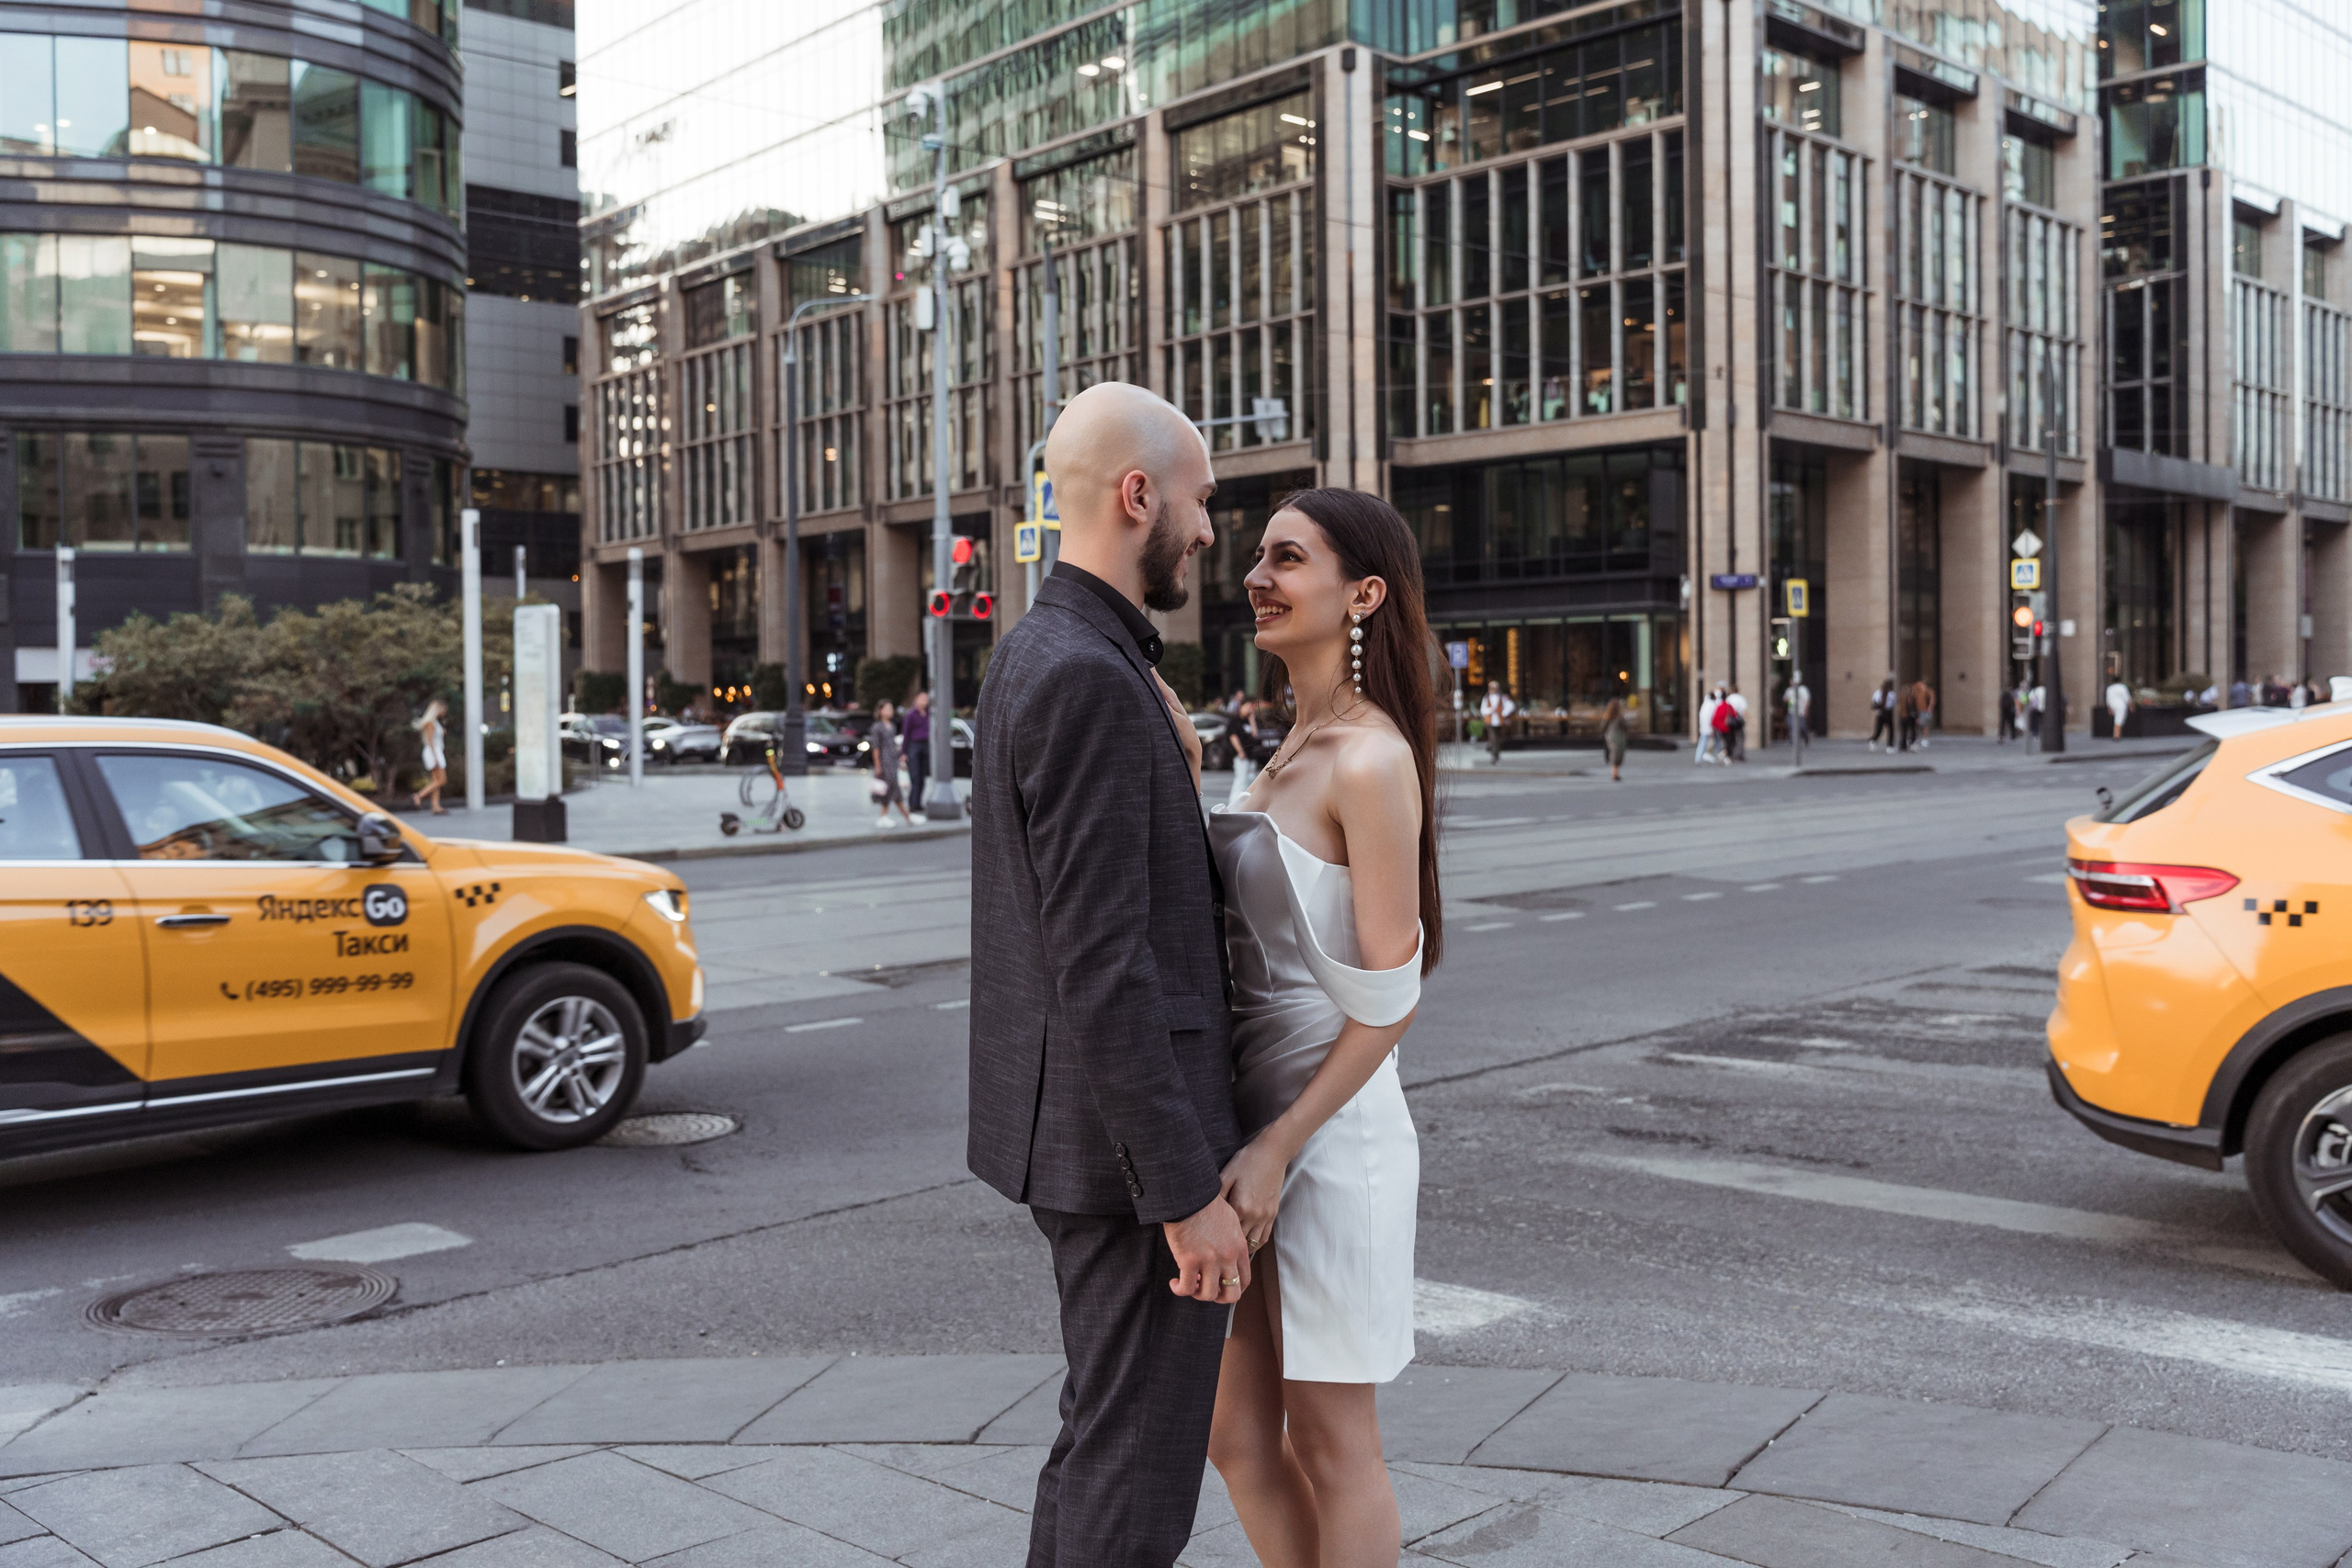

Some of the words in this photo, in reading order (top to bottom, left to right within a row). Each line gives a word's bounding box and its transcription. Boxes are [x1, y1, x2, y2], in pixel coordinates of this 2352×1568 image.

[67, 899, 113, 927] 139
[257, 895, 361, 922] Яндекс
[365, 890, 406, 919] Go
[333, 931, 409, 957] Такси
[245, 979, 303, 1001] (495)
[309, 972, 413, 996] 999-99-99
